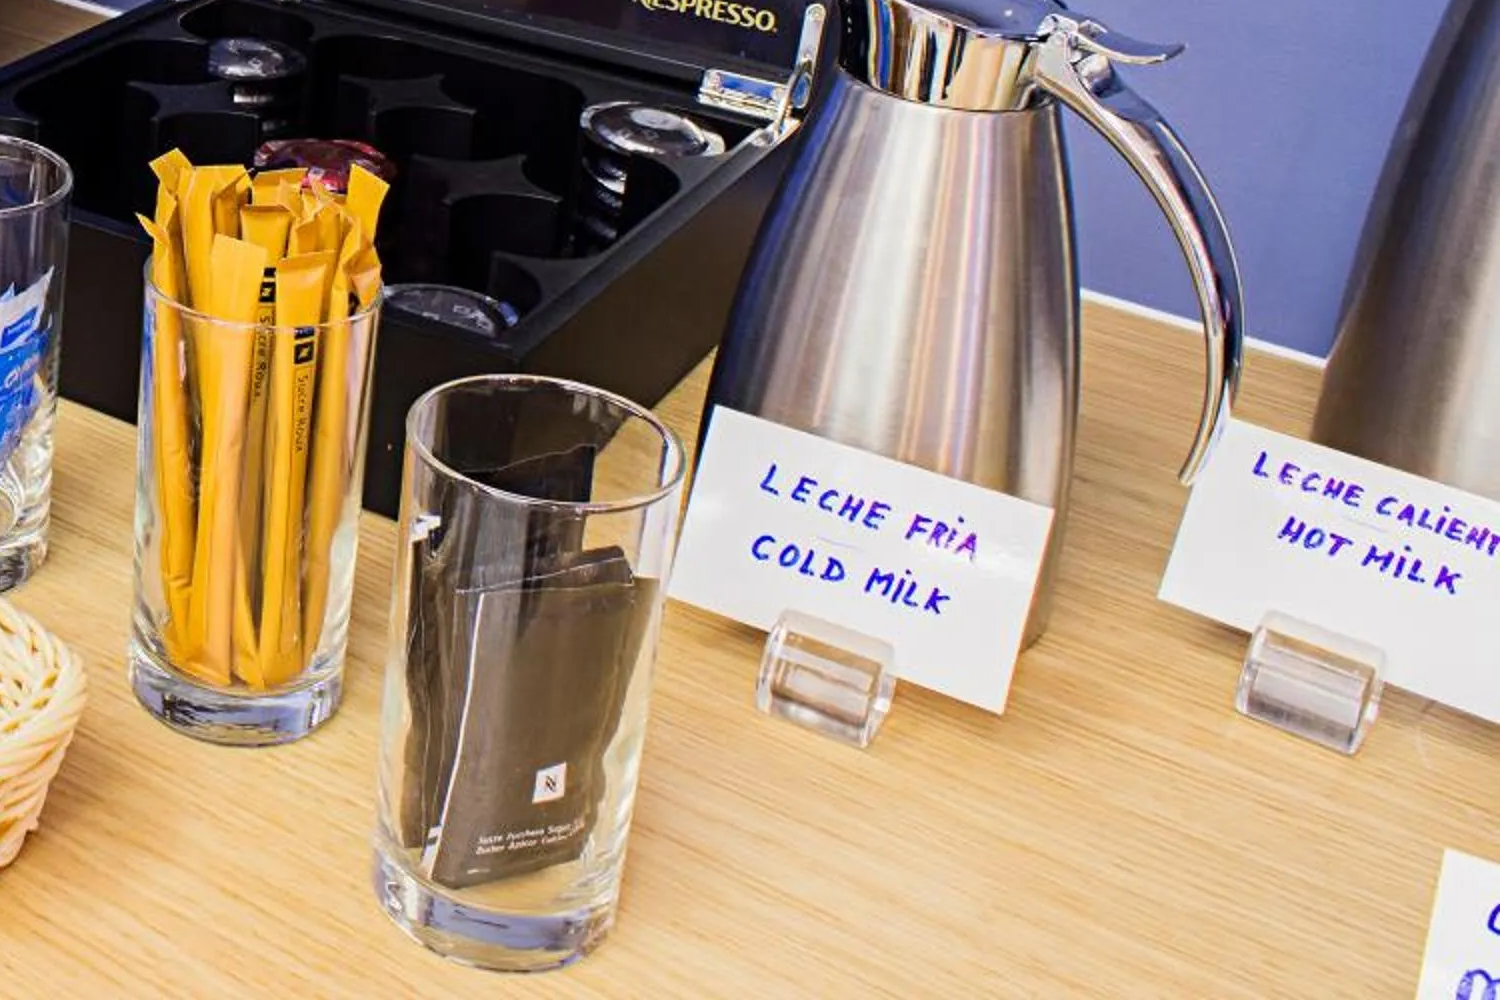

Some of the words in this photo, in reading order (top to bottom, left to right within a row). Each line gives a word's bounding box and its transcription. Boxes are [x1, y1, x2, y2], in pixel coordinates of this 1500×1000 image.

[759, 463, 892, 530] LECHE
[1251, 450, 1365, 508] LECHE
[751, 534, 846, 583] COLD
[1277, 516, 1353, 557] HOT
